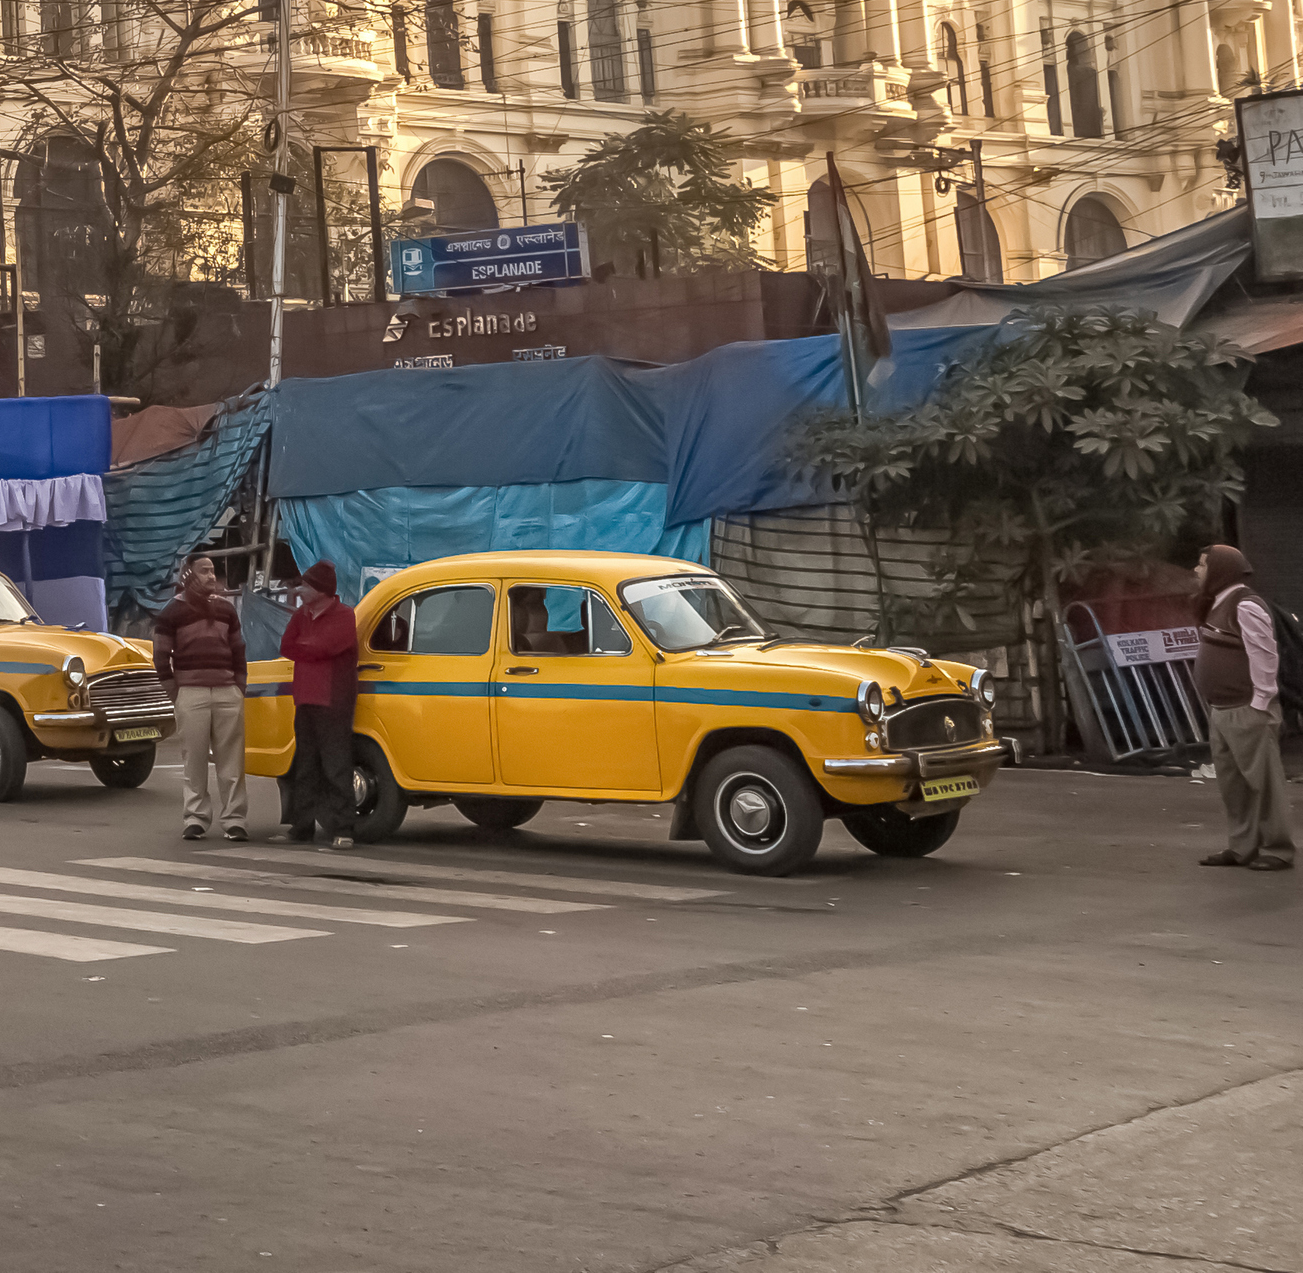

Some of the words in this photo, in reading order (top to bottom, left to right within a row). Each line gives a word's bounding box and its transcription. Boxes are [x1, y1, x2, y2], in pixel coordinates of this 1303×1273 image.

[472, 260, 543, 280] ESPLANADE
[1117, 638, 1149, 647] KOLKATA
[1120, 646, 1149, 655] TRAFFIC
[1125, 653, 1151, 662] POLICE
